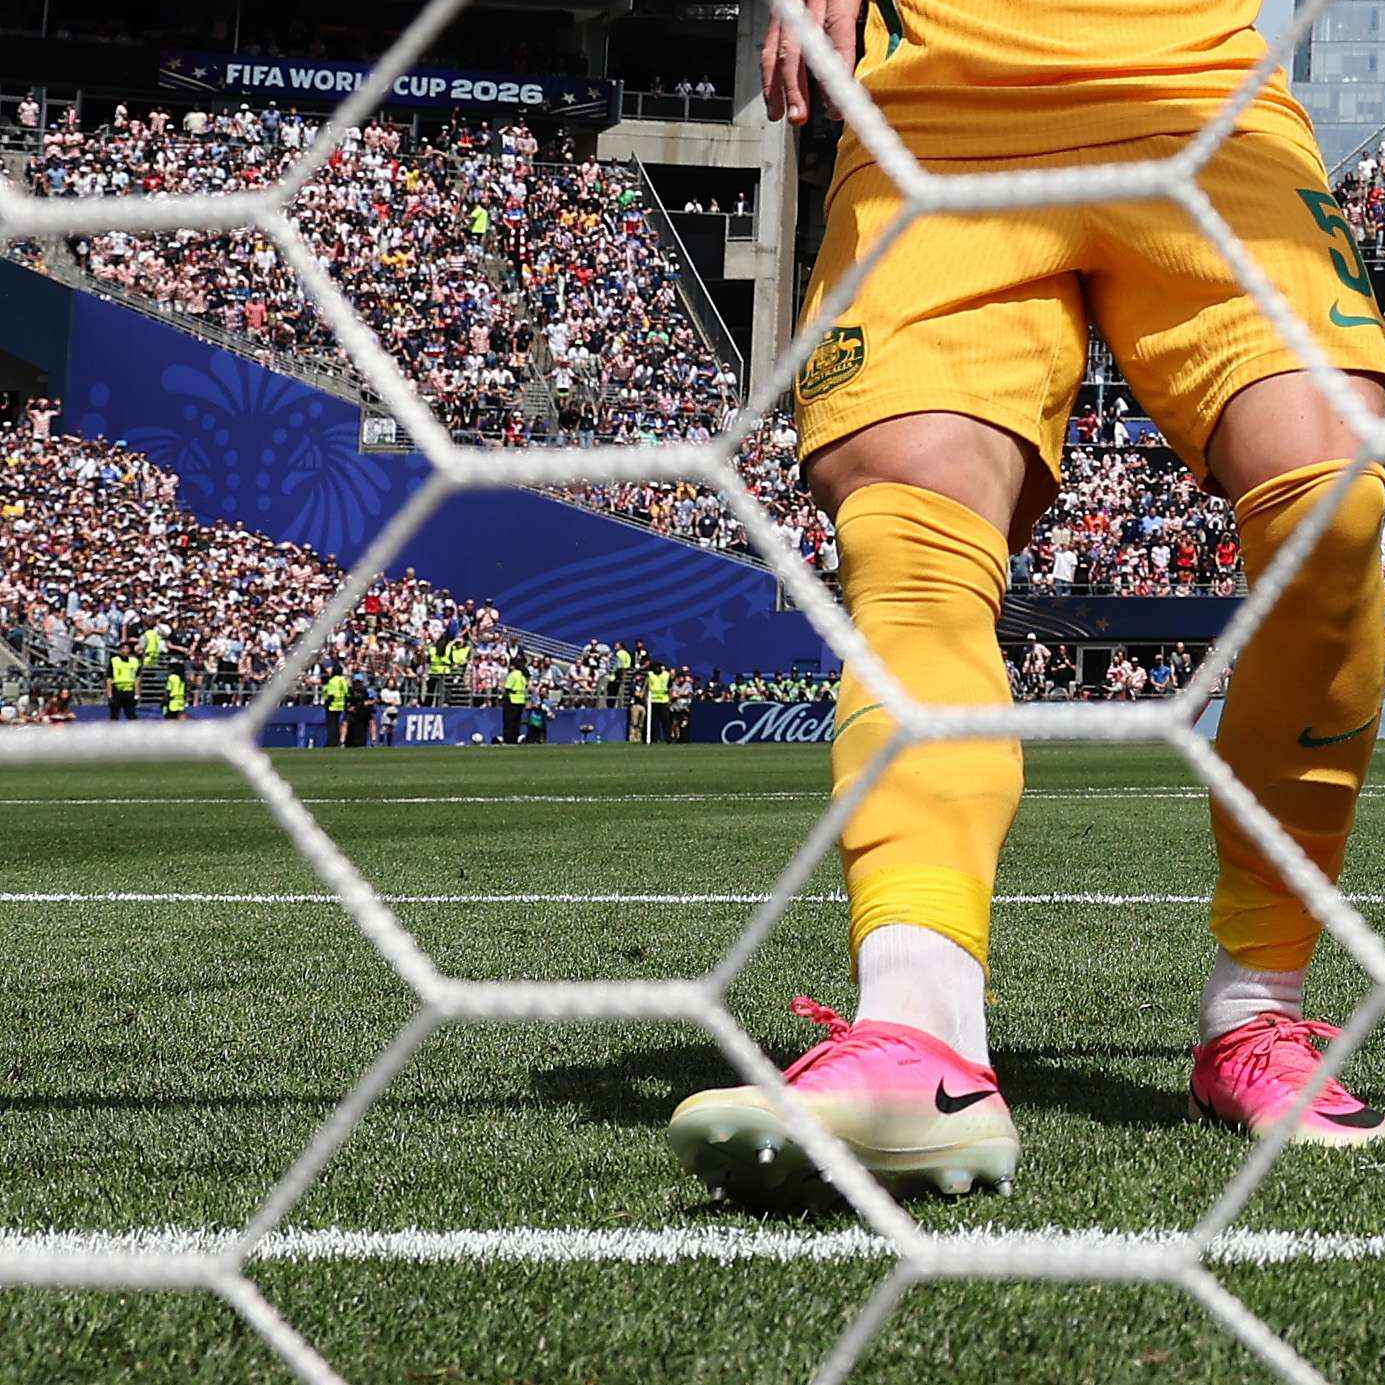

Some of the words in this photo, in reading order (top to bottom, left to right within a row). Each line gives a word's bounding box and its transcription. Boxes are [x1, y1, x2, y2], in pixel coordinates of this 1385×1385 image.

[226, 64, 285, 88] FIFA
[394, 75, 447, 97] CUP
[450, 78, 545, 104] 2026
[1295, 187, 1373, 297] 5
[405, 714, 445, 741] FIFA
[721, 702, 838, 745] Mich
